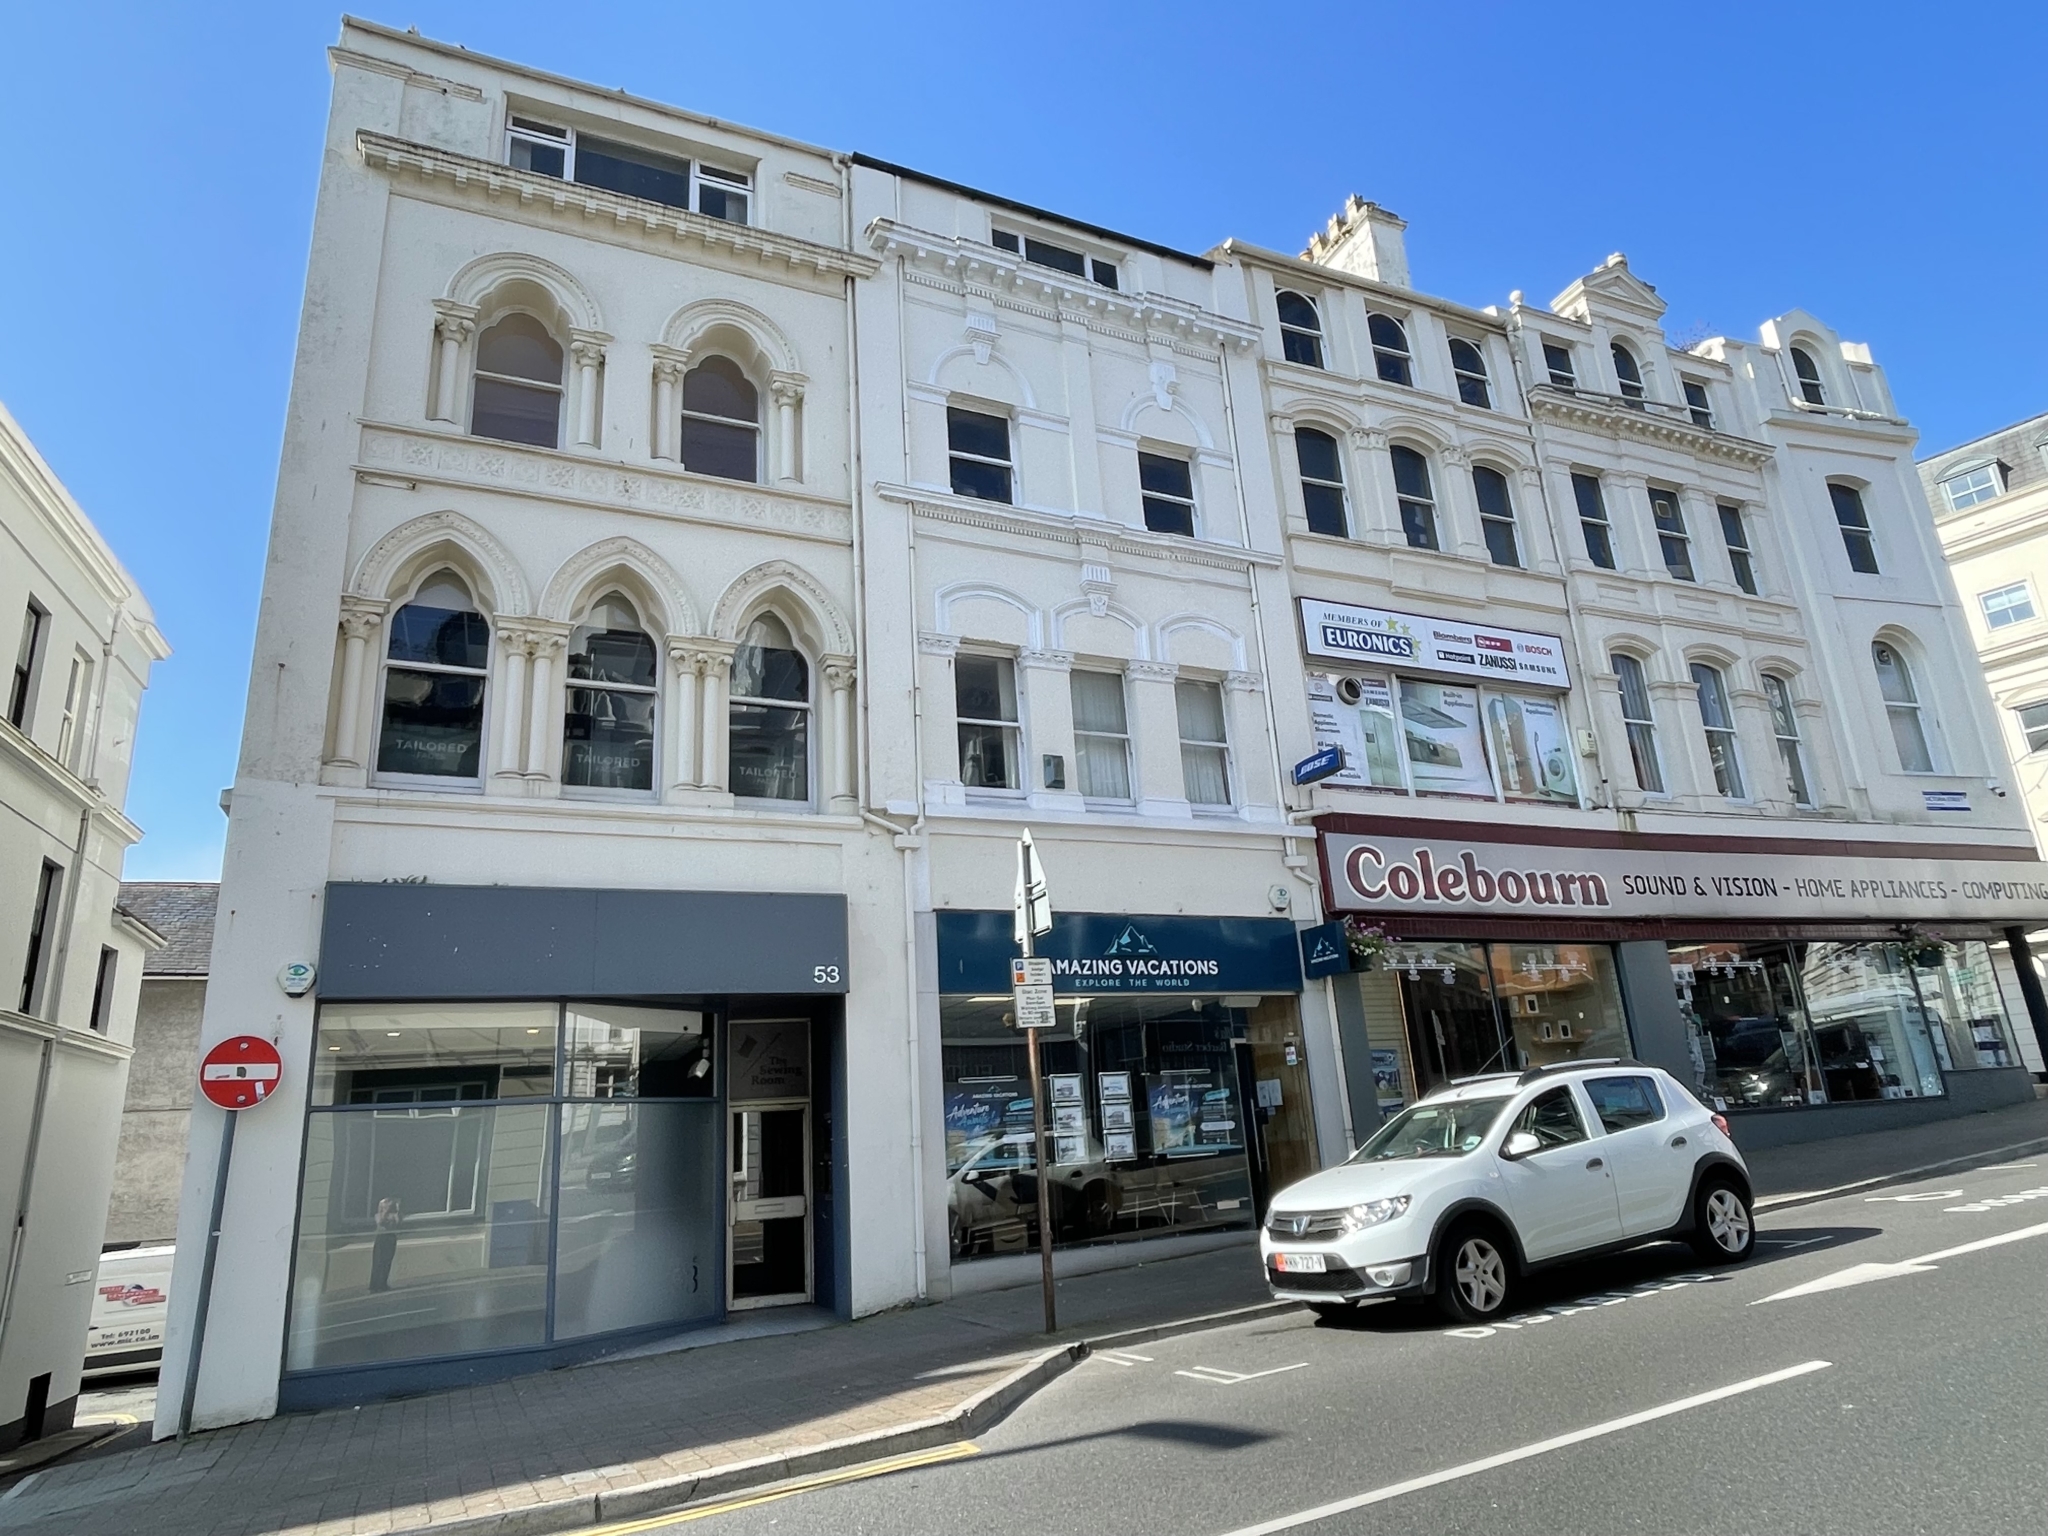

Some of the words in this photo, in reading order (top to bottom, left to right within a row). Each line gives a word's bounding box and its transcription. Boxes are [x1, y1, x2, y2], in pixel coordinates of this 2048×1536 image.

[1322, 612, 1369, 626] MEMBERS
[1370, 620, 1382, 628] OF
[1326, 628, 1411, 655] EURONICS
[1524, 644, 1553, 656] BOSCH
[1445, 652, 1472, 663] Hotpoint
[1477, 653, 1518, 671] ZANUSSI
[1519, 662, 1557, 674] SAMSUNG
[396, 739, 467, 753] TAILORED
[576, 753, 640, 767] TAILORED
[1297, 754, 1334, 777] BOSE
[739, 766, 797, 779] TAILORED
[1346, 845, 1611, 906] Colebourn
[1622, 874, 1687, 896] SOUND
[1693, 876, 1708, 897] &
[1710, 876, 1779, 897] VISION
[1794, 877, 1846, 898] HOME
[1850, 879, 1948, 899] APPLIANCES
[1961, 881, 2048, 900] COMPUTING
[813, 965, 840, 983] 53
[1126, 959, 1219, 975] VACATIONS
[1075, 978, 1121, 987] EXPLORE
[1129, 978, 1148, 987] THE
[1155, 978, 1190, 987] WORLD
[769, 1056, 787, 1065] The
[758, 1064, 803, 1077] Sewing
[751, 1075, 786, 1086] Room
[946, 1102, 990, 1122] Adventure
[101, 1332, 115, 1340] Tel:
[118, 1327, 151, 1338] 692100
